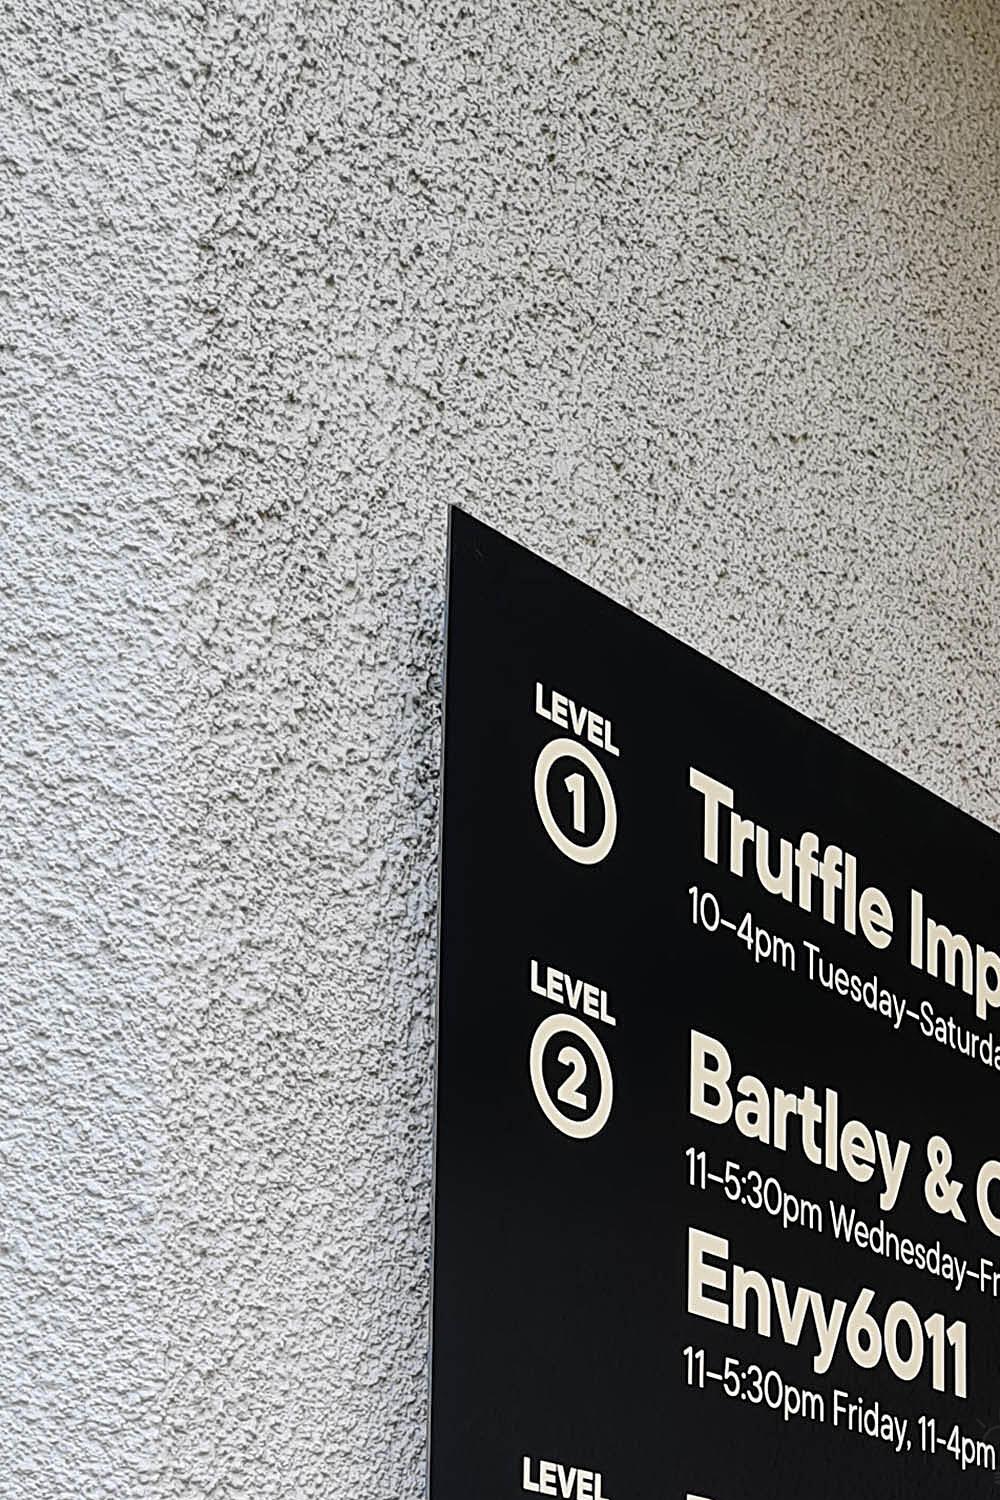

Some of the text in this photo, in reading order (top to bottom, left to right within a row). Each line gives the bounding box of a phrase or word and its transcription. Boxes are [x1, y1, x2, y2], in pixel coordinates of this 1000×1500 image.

[535, 681, 620, 757] LEVEL
[563, 772, 586, 834] 1
[689, 766, 894, 950] Truffle
[530, 959, 617, 1027] LEVEL
[557, 1045, 587, 1111] 2
[689, 1028, 911, 1212] Bartley
[924, 1135, 967, 1223] &
[687, 1226, 967, 1399] Envy6011
[833, 1389, 912, 1453] Friday,
